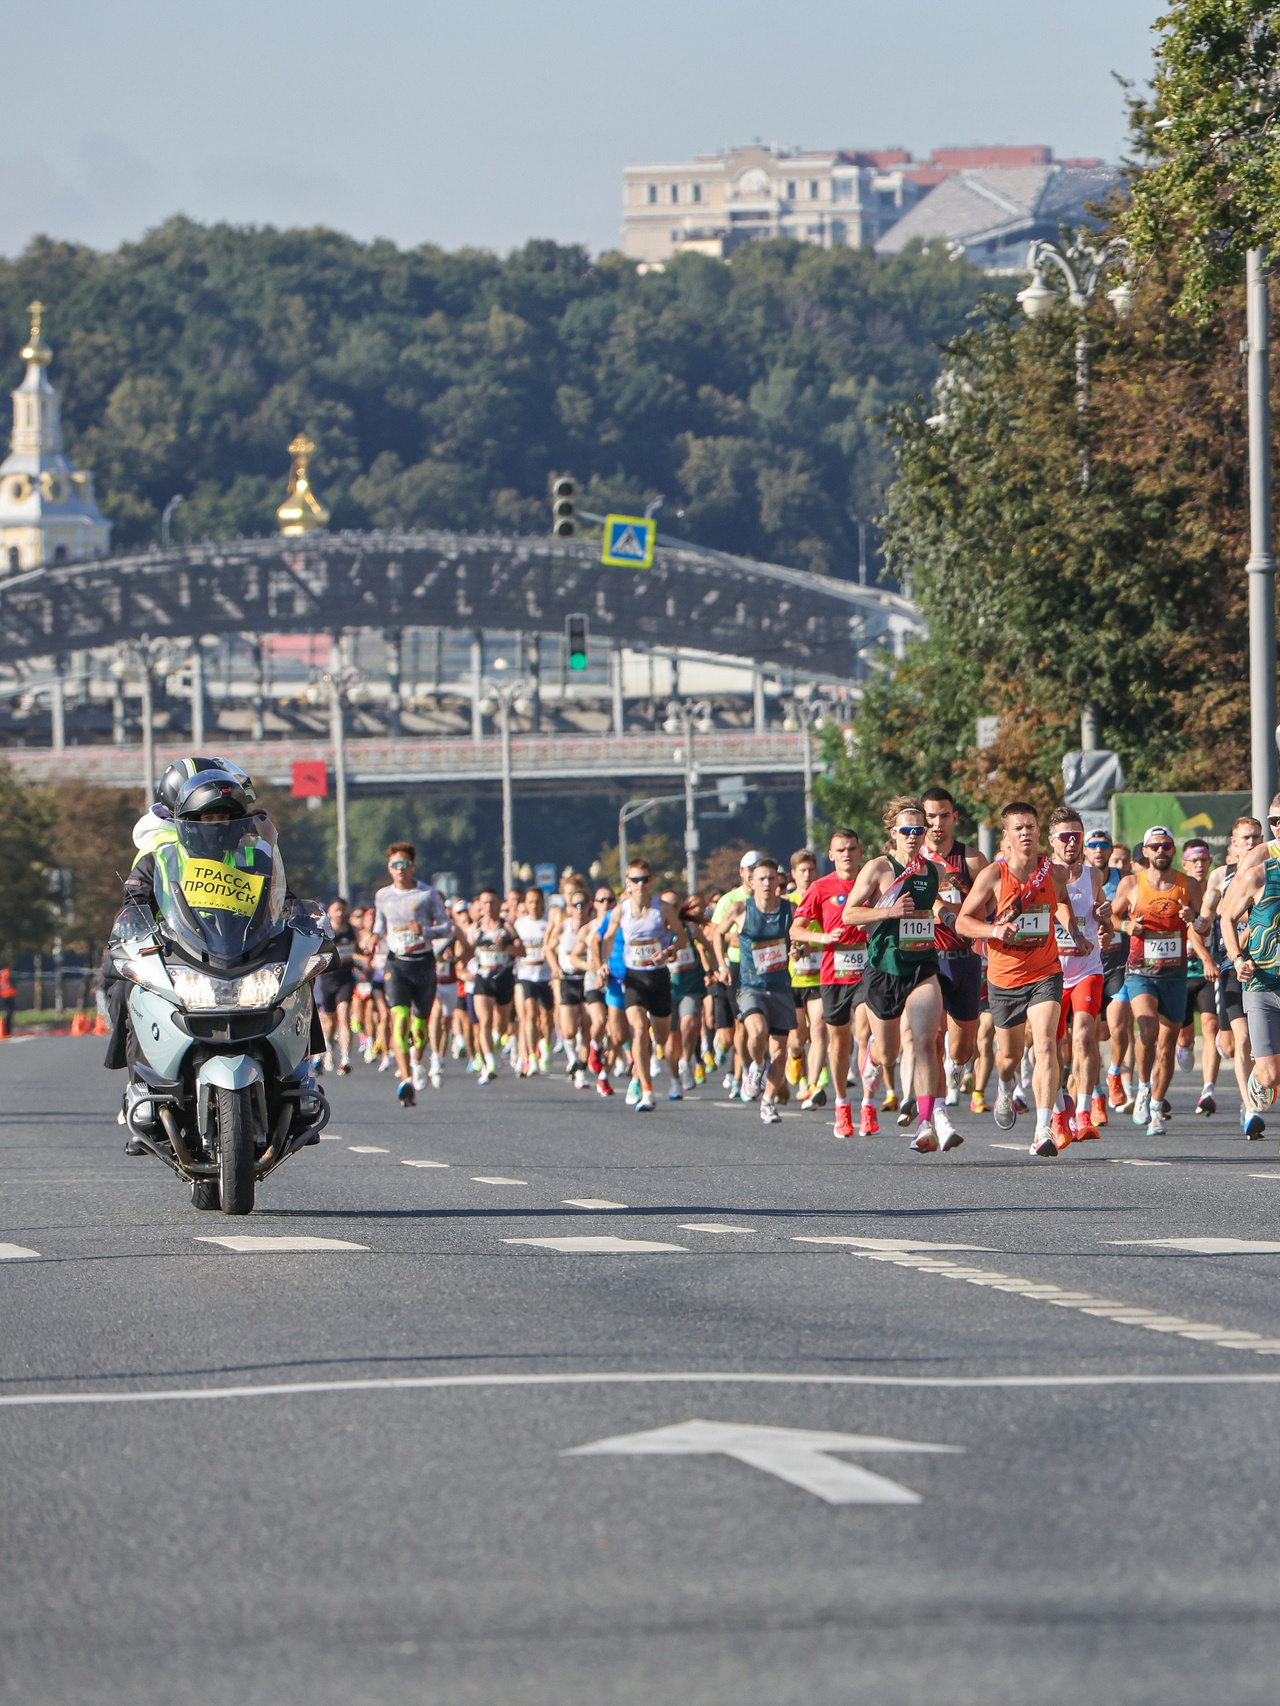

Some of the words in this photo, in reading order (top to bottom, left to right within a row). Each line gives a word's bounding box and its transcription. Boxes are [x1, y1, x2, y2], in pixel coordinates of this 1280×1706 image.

[194, 867, 252, 892] ТРАССА
[184, 880, 257, 905] ПРОПУСК
[904, 922, 931, 934] 110-1
[1151, 942, 1176, 952] 7413
[758, 949, 782, 962] 8234
[844, 953, 863, 964] 468
